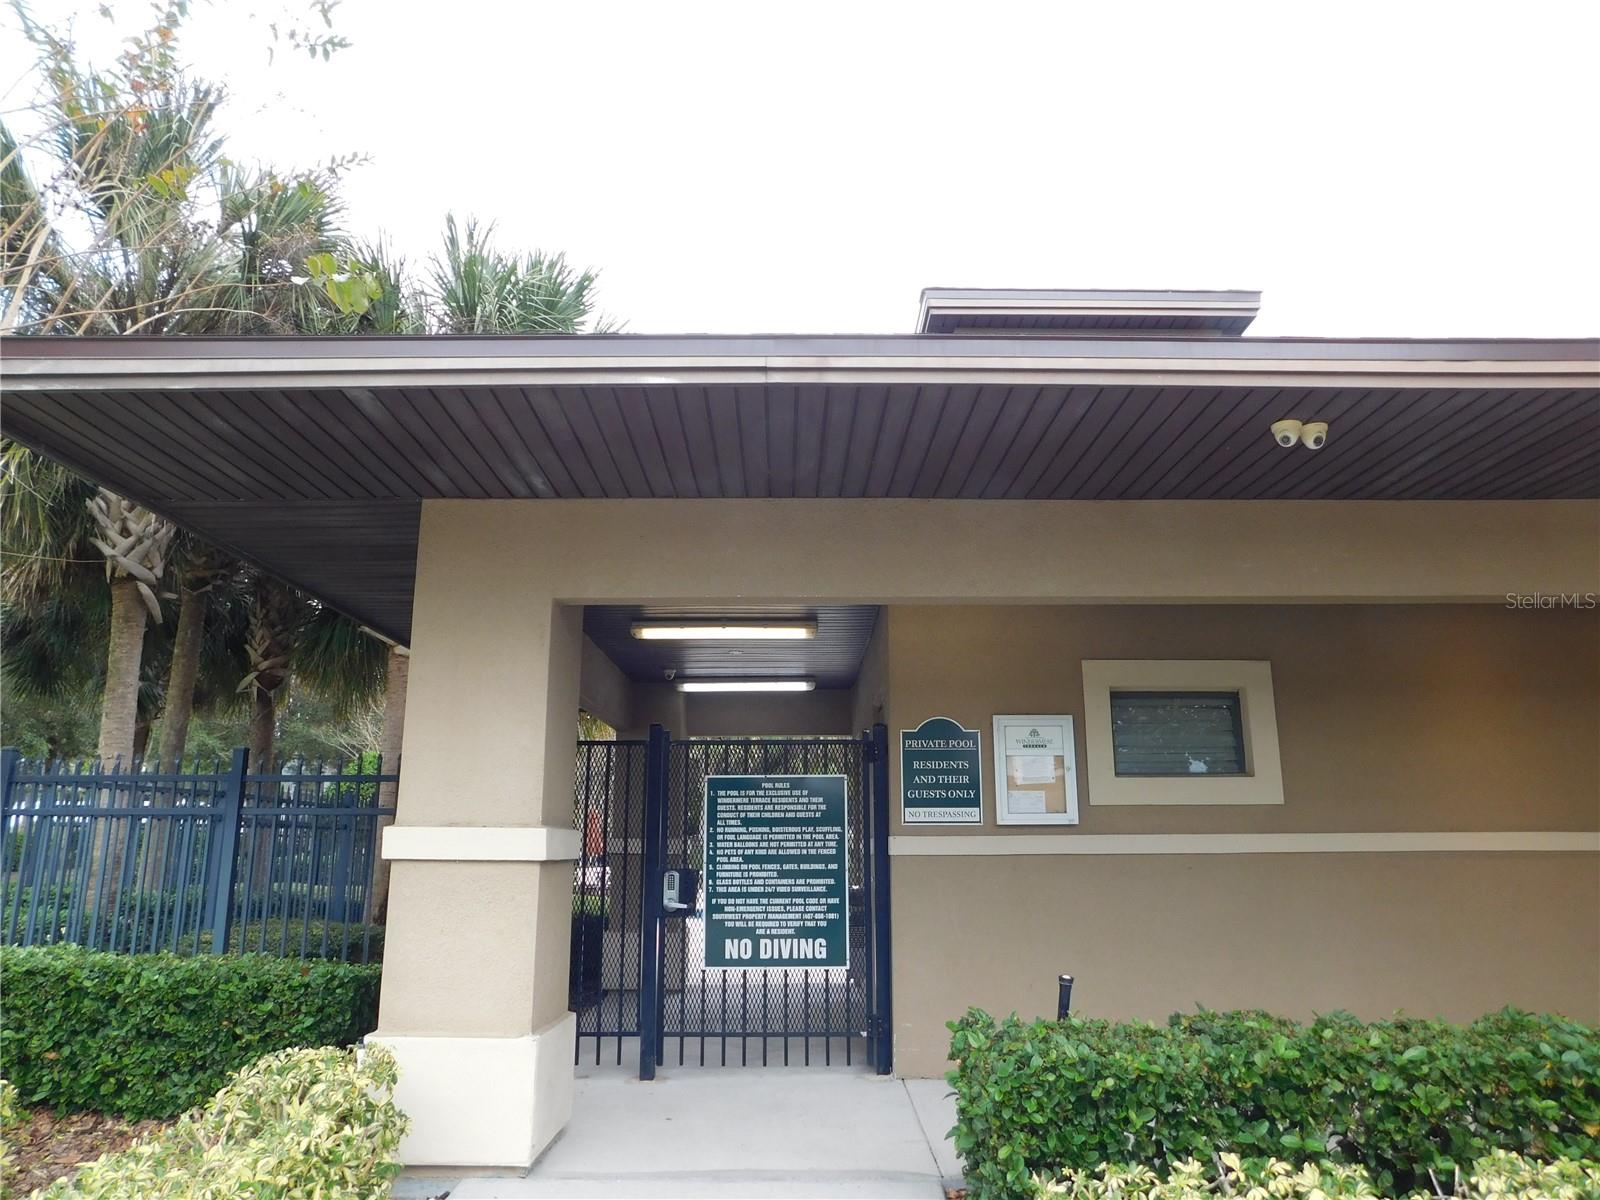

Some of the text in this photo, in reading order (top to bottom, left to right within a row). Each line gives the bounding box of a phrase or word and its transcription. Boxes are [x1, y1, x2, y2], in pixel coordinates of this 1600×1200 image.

[905, 739, 976, 748] PRIVATE POOL
[913, 761, 969, 769] RESIDENTS
[913, 775, 970, 784] AND THEIR
[907, 790, 976, 798] GUESTS ONLY
[908, 809, 976, 818] NO TRESPASSING
[724, 938, 827, 959] NO DIVING
